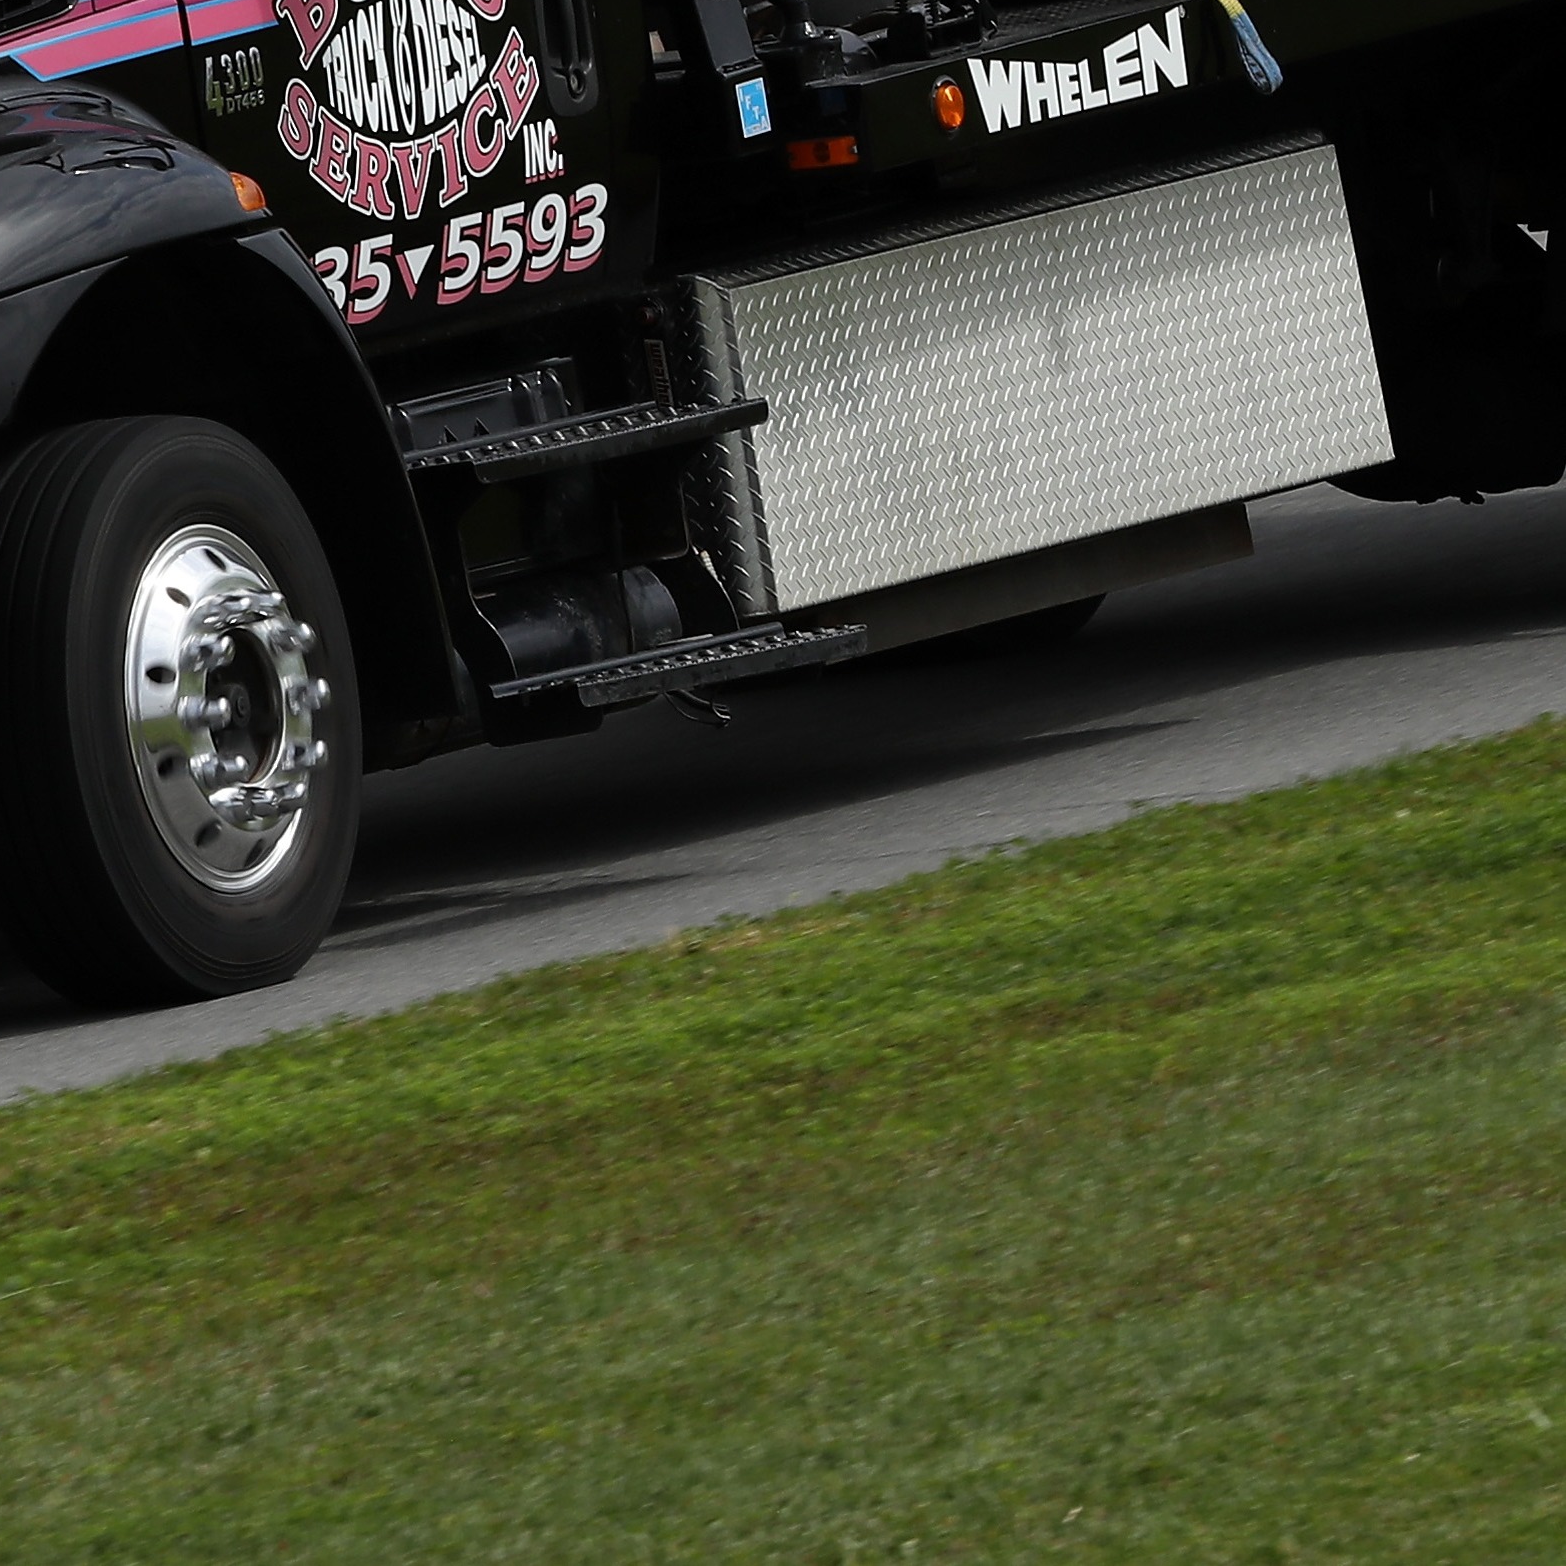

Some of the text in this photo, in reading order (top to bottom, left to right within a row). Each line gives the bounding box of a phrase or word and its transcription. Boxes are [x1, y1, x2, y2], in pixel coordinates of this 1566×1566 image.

[205, 46, 264, 117] 4300
[278, 26, 540, 220] SERVICE
[322, 1, 399, 133] TRUCK
[967, 5, 1189, 134] WHELEN
[523, 118, 565, 184] INC.
[437, 183, 608, 305] 5593
